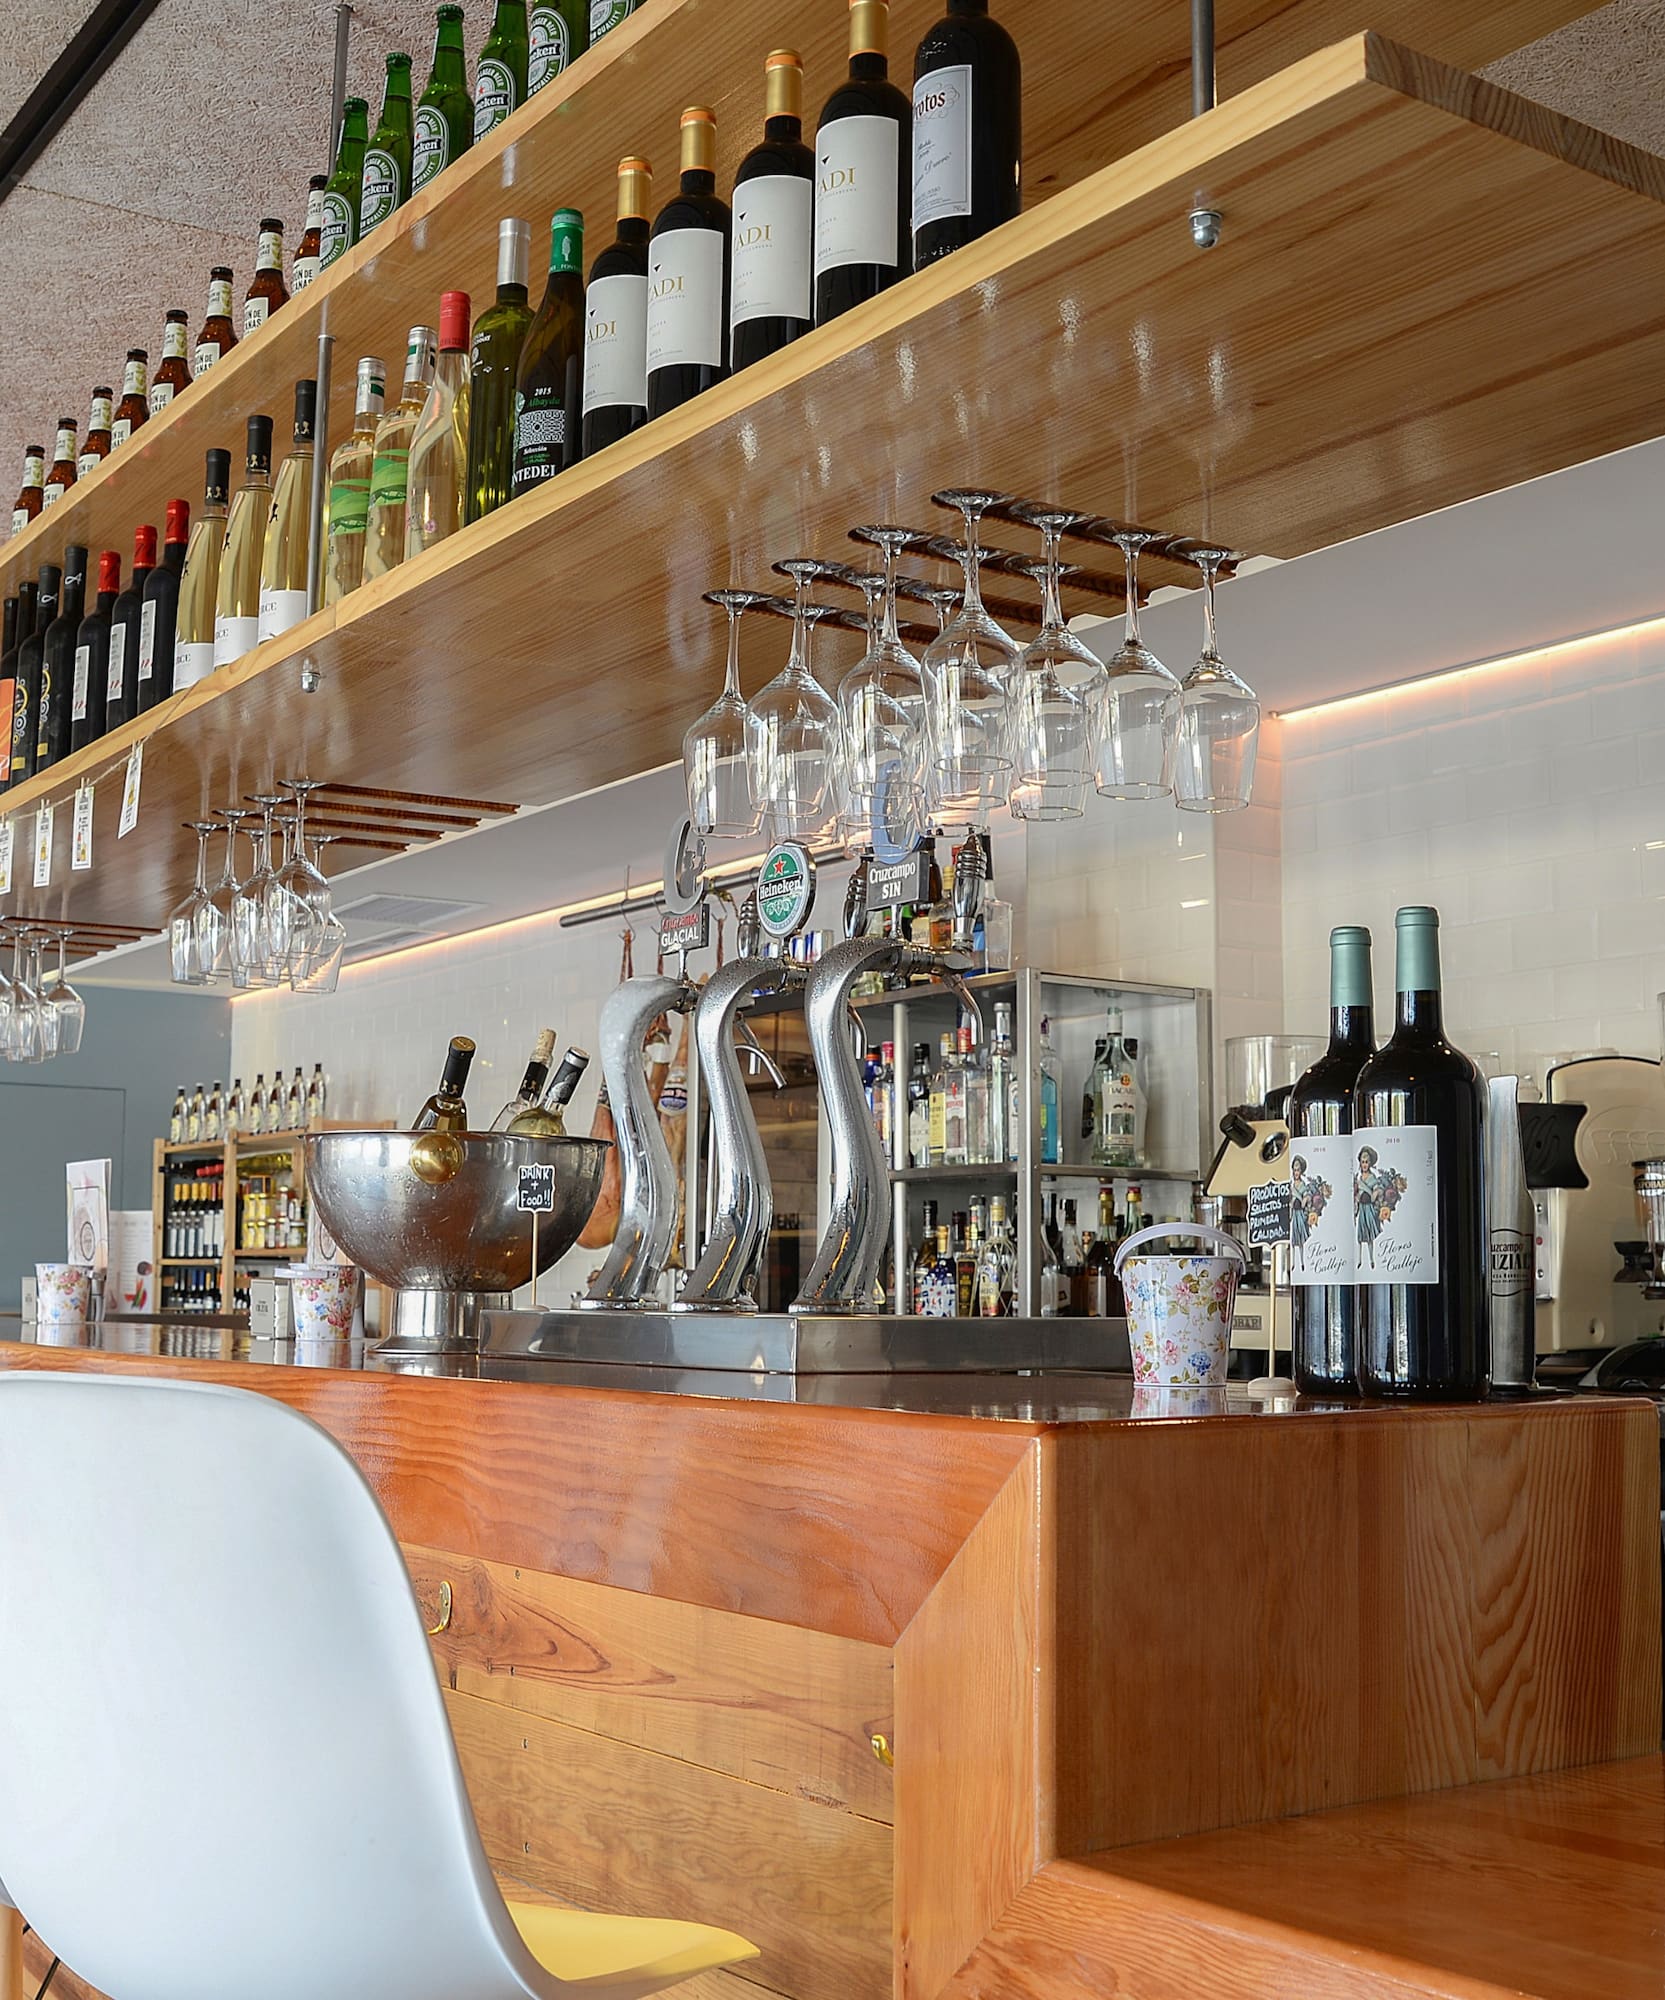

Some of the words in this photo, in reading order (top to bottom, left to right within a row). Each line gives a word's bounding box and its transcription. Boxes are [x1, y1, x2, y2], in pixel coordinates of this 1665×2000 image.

[534, 387, 552, 396] 2015
[870, 862, 916, 884] Cruzcampo
[760, 875, 801, 900] Heineken
[882, 881, 903, 899] SIN
[661, 926, 699, 947] GLACIAL
[521, 1167, 549, 1181] DRINK
[1307, 1241, 1337, 1259] Flores
[1378, 1237, 1412, 1257] Flores
[1314, 1257, 1347, 1275] Callejo
[1386, 1254, 1423, 1273] Callejo
